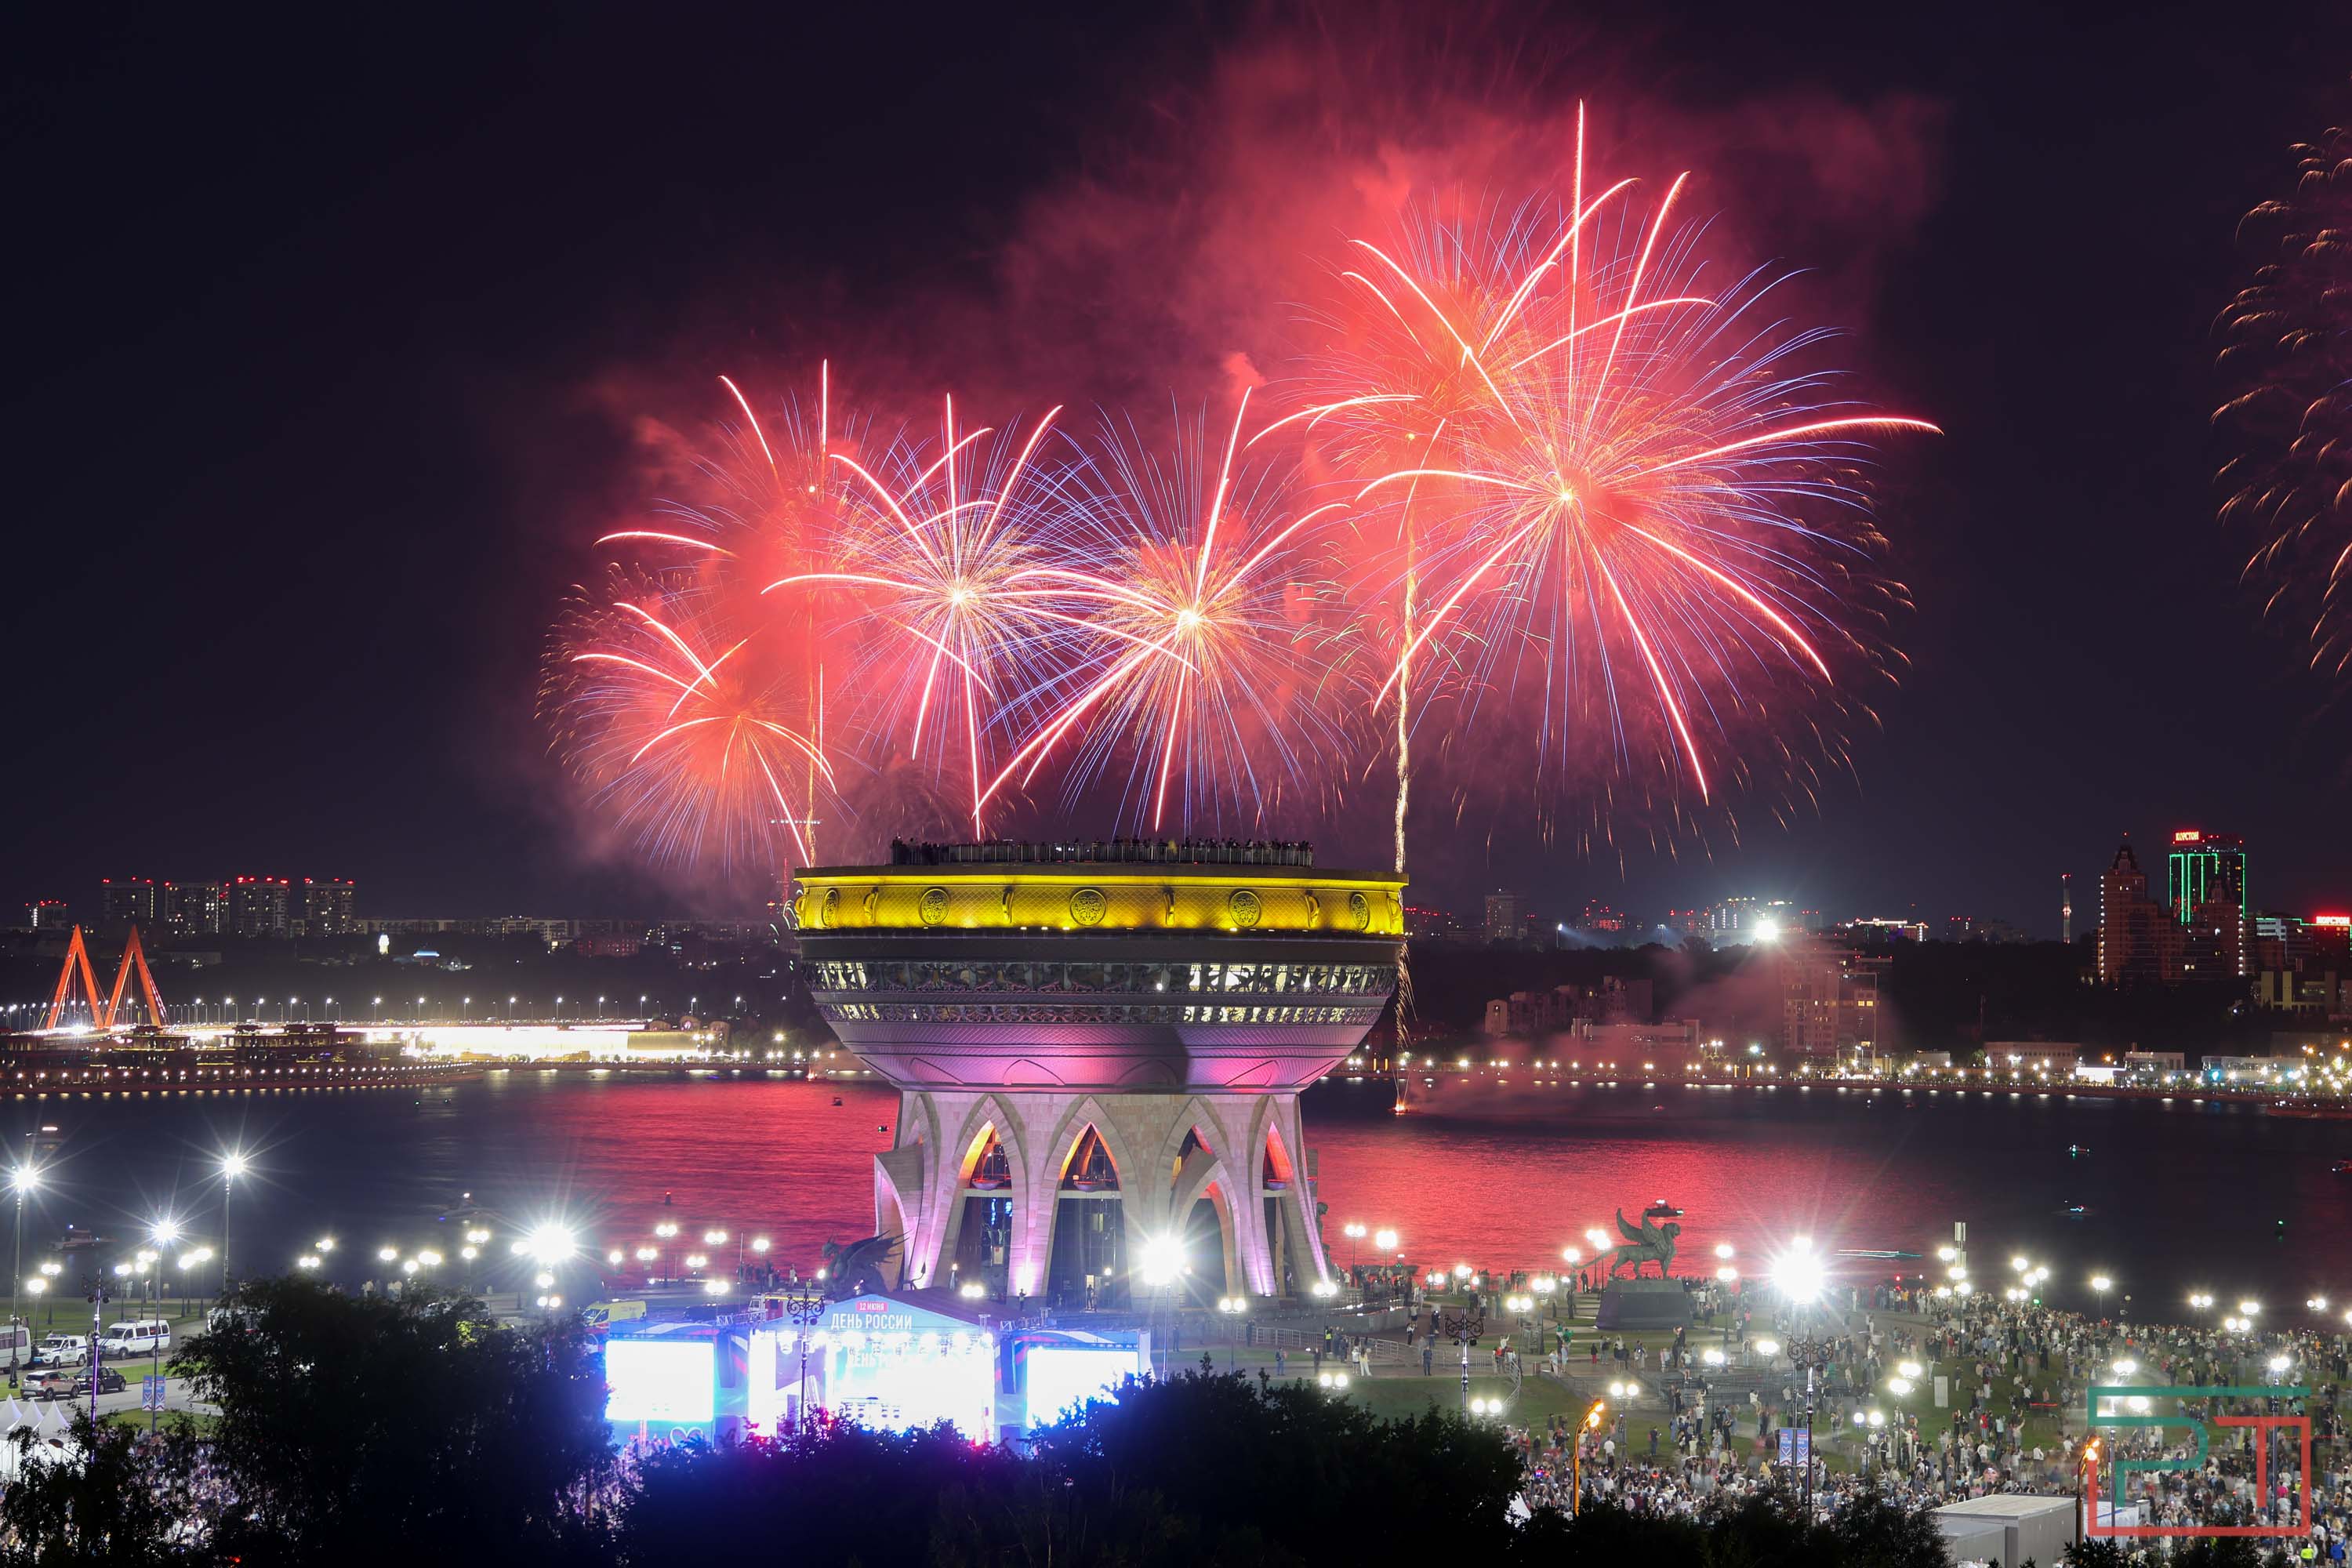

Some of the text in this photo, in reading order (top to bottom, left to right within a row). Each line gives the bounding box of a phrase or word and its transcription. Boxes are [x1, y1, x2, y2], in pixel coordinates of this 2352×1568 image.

[2175, 831, 2199, 840] КОРСТОН
[859, 1302, 884, 1312] 12 ИЮНЯ
[831, 1313, 912, 1330] ДЕНЬ РОССИИ
